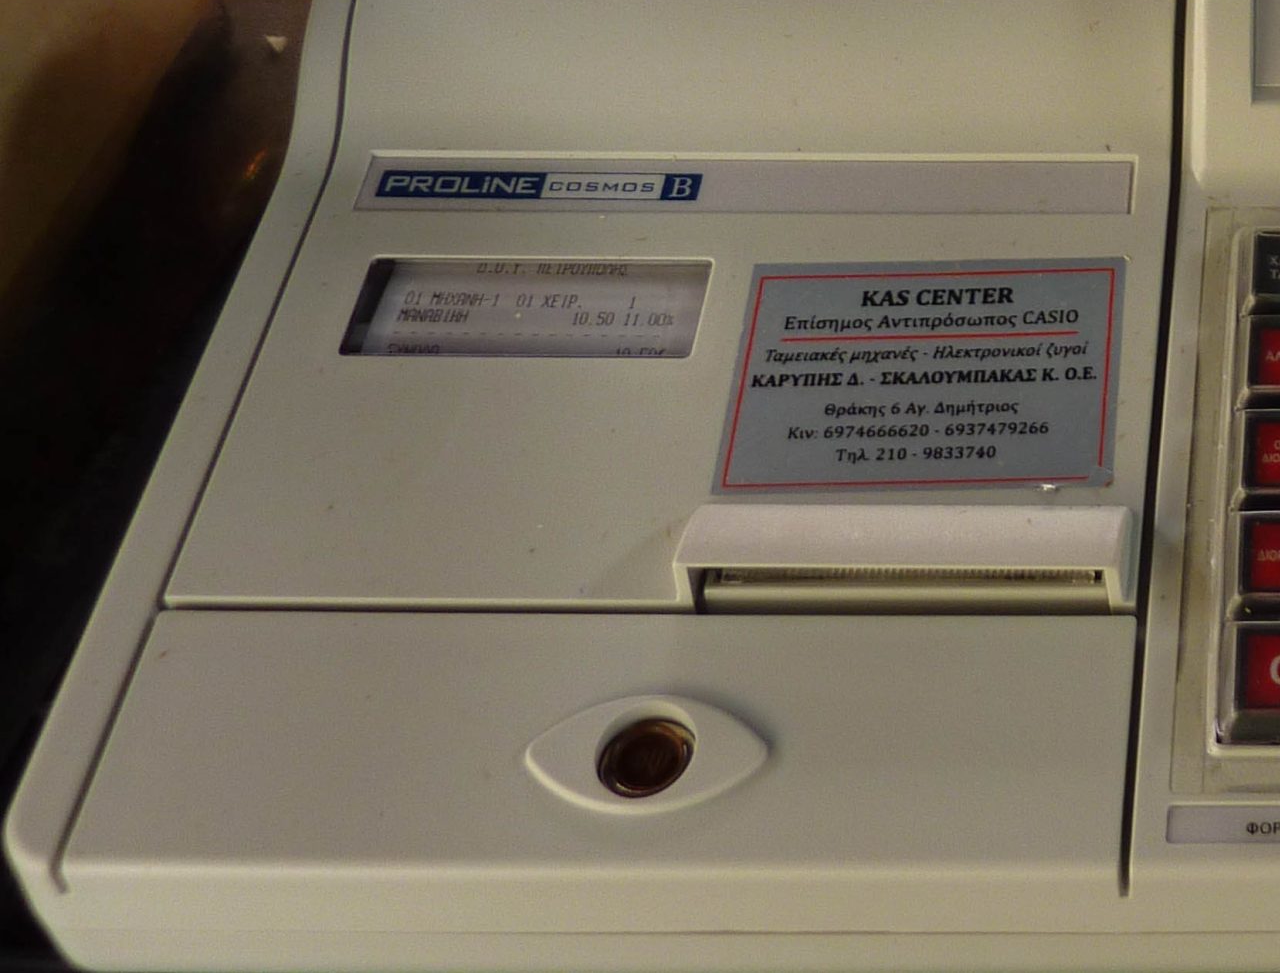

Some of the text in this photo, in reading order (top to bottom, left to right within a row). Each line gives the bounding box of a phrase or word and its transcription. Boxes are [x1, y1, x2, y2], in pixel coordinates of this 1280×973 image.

[548, 181, 655, 193] COSMOS
[669, 177, 692, 197] B
[861, 287, 1014, 308] KAS CENTER
[784, 309, 1079, 333] Επίσημος Αντιπρόσωπος CASIO
[765, 347, 848, 365] Ταμειακές
[849, 346, 917, 364] μηχανές
[933, 342, 1043, 362] Ηλεκτρονικοί
[1046, 341, 1088, 359] ζυγοί
[750, 372, 844, 389] ΚΑΡΥΠΗΣ
[847, 371, 865, 387] Δ.
[880, 368, 1037, 387] ΣΚΑΛΟΥΜΠΑΚΑΣ
[1064, 366, 1097, 382] Ο.Ε.
[824, 399, 1019, 420] Θράκης 6 Αγ. Δημήτριος
[787, 426, 819, 441] Κιν:
[823, 424, 930, 439] 6974666620
[945, 422, 1050, 437] 6937479266
[876, 447, 907, 461] 210
[923, 445, 997, 460] 9833740
